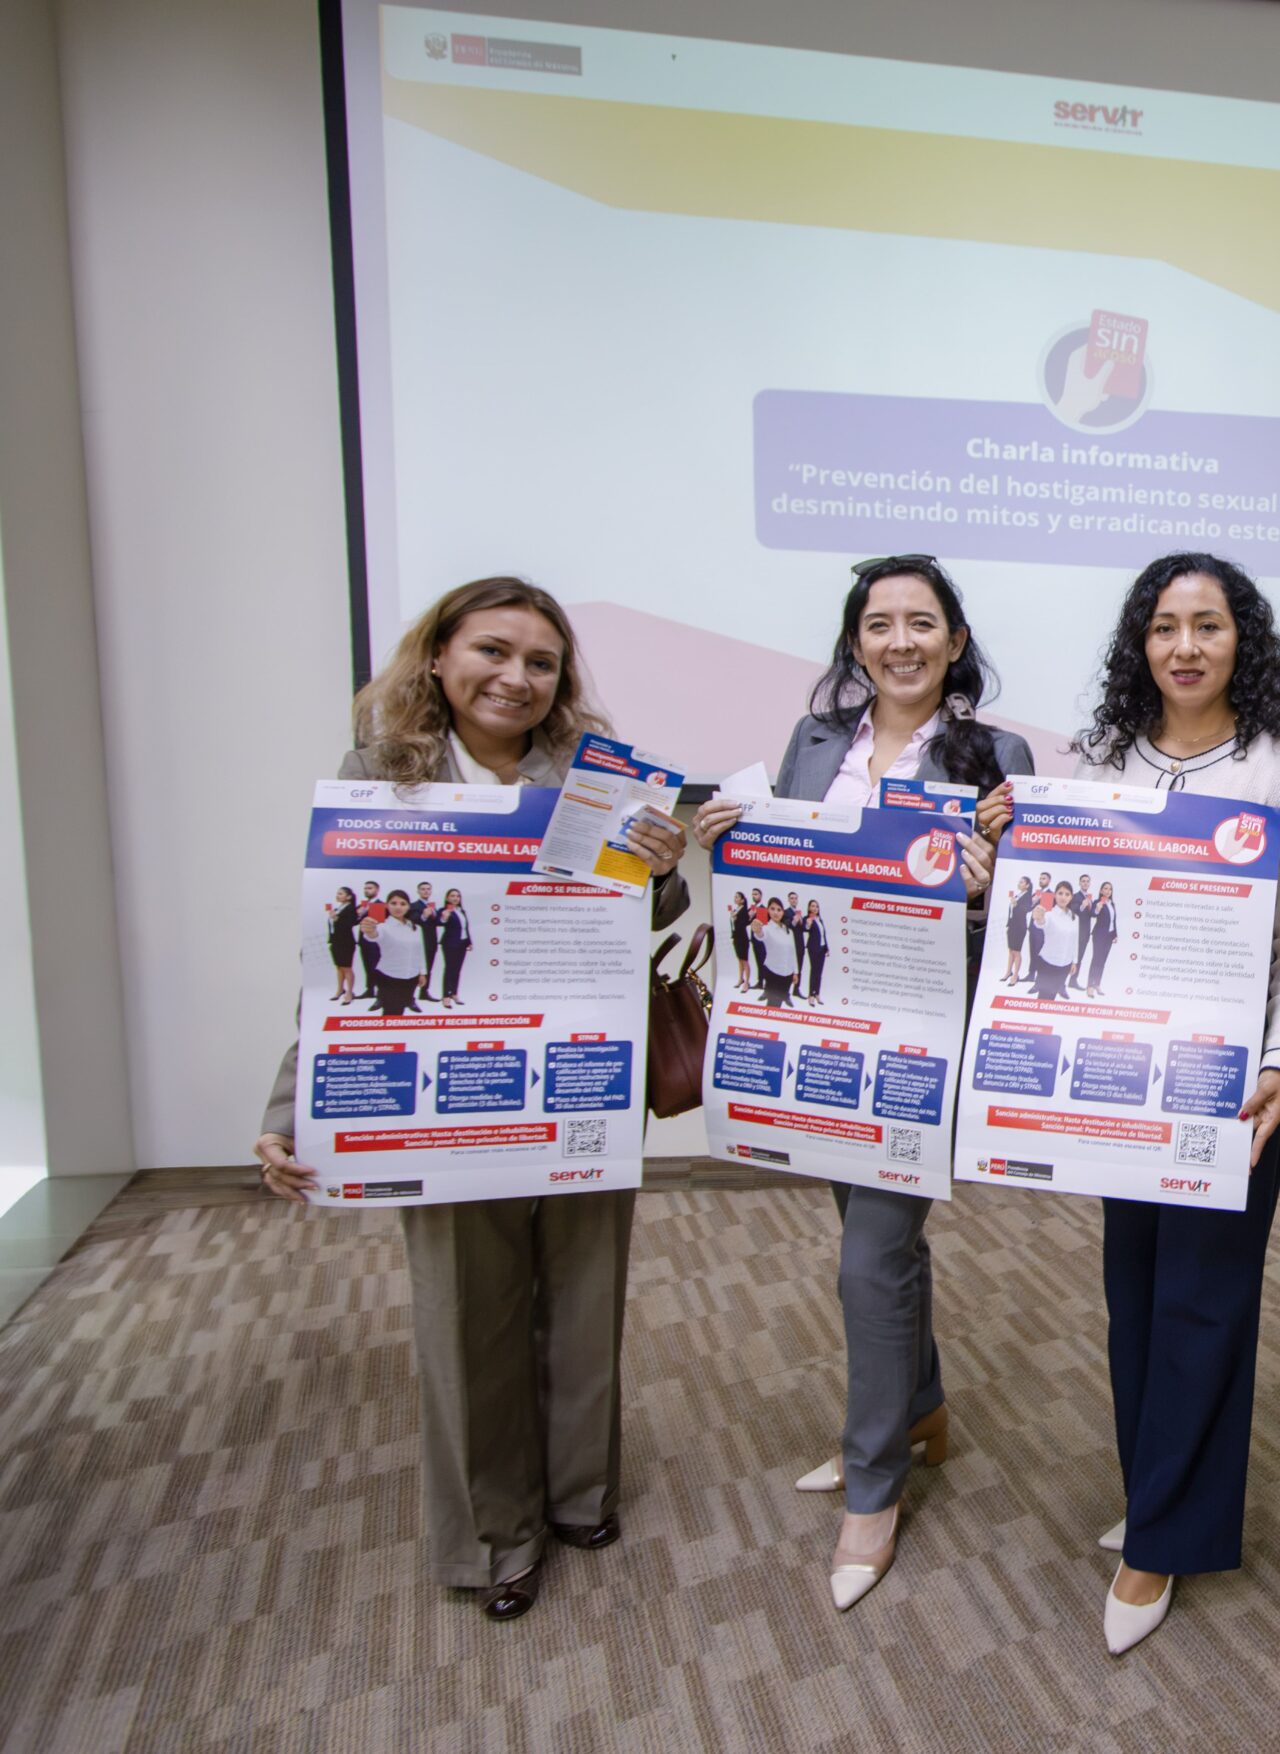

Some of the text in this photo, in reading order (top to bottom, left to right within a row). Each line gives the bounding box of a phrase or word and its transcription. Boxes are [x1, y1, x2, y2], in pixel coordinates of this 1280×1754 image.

[1096, 328, 1138, 354] sin
[966, 438, 1219, 473] Charla informativa
[788, 463, 951, 493] “Prevención
[960, 474, 998, 496] del
[1007, 476, 1191, 508] hostigamiento
[1198, 492, 1278, 512] sexual
[771, 492, 958, 523] desmintiendo
[966, 504, 1040, 528] mitos
[1047, 513, 1062, 534] y
[1069, 513, 1222, 538] erradicando
[350, 789, 374, 798] GFP
[1031, 784, 1049, 794] GFP
[337, 819, 458, 832] TODOS CONTRA EL
[1022, 814, 1113, 828] TODOS CONTRA EL
[1240, 820, 1261, 832] sin
[336, 838, 454, 853] HOSTIGAMIENTO
[458, 842, 510, 855] SEXUAL
[730, 831, 814, 848] TODOS CONTRA EL
[931, 837, 951, 850] sin
[1021, 832, 1209, 856] HOSTIGAMIENTO SEXUAL LABORAL
[731, 849, 903, 877] HOSTIGAMIENTO SEXUAL LABORAL
[1162, 880, 1188, 890] ¿CÓMO
[1200, 884, 1239, 894] PRESENTA?
[1004, 1000, 1038, 1009] PODEMOS
[1040, 1003, 1079, 1012] DENUNCIAR
[1088, 1007, 1113, 1015] RECIBIR
[550, 1168, 604, 1181] servir
[878, 1170, 920, 1184] servir
[1160, 1177, 1211, 1192] servir
